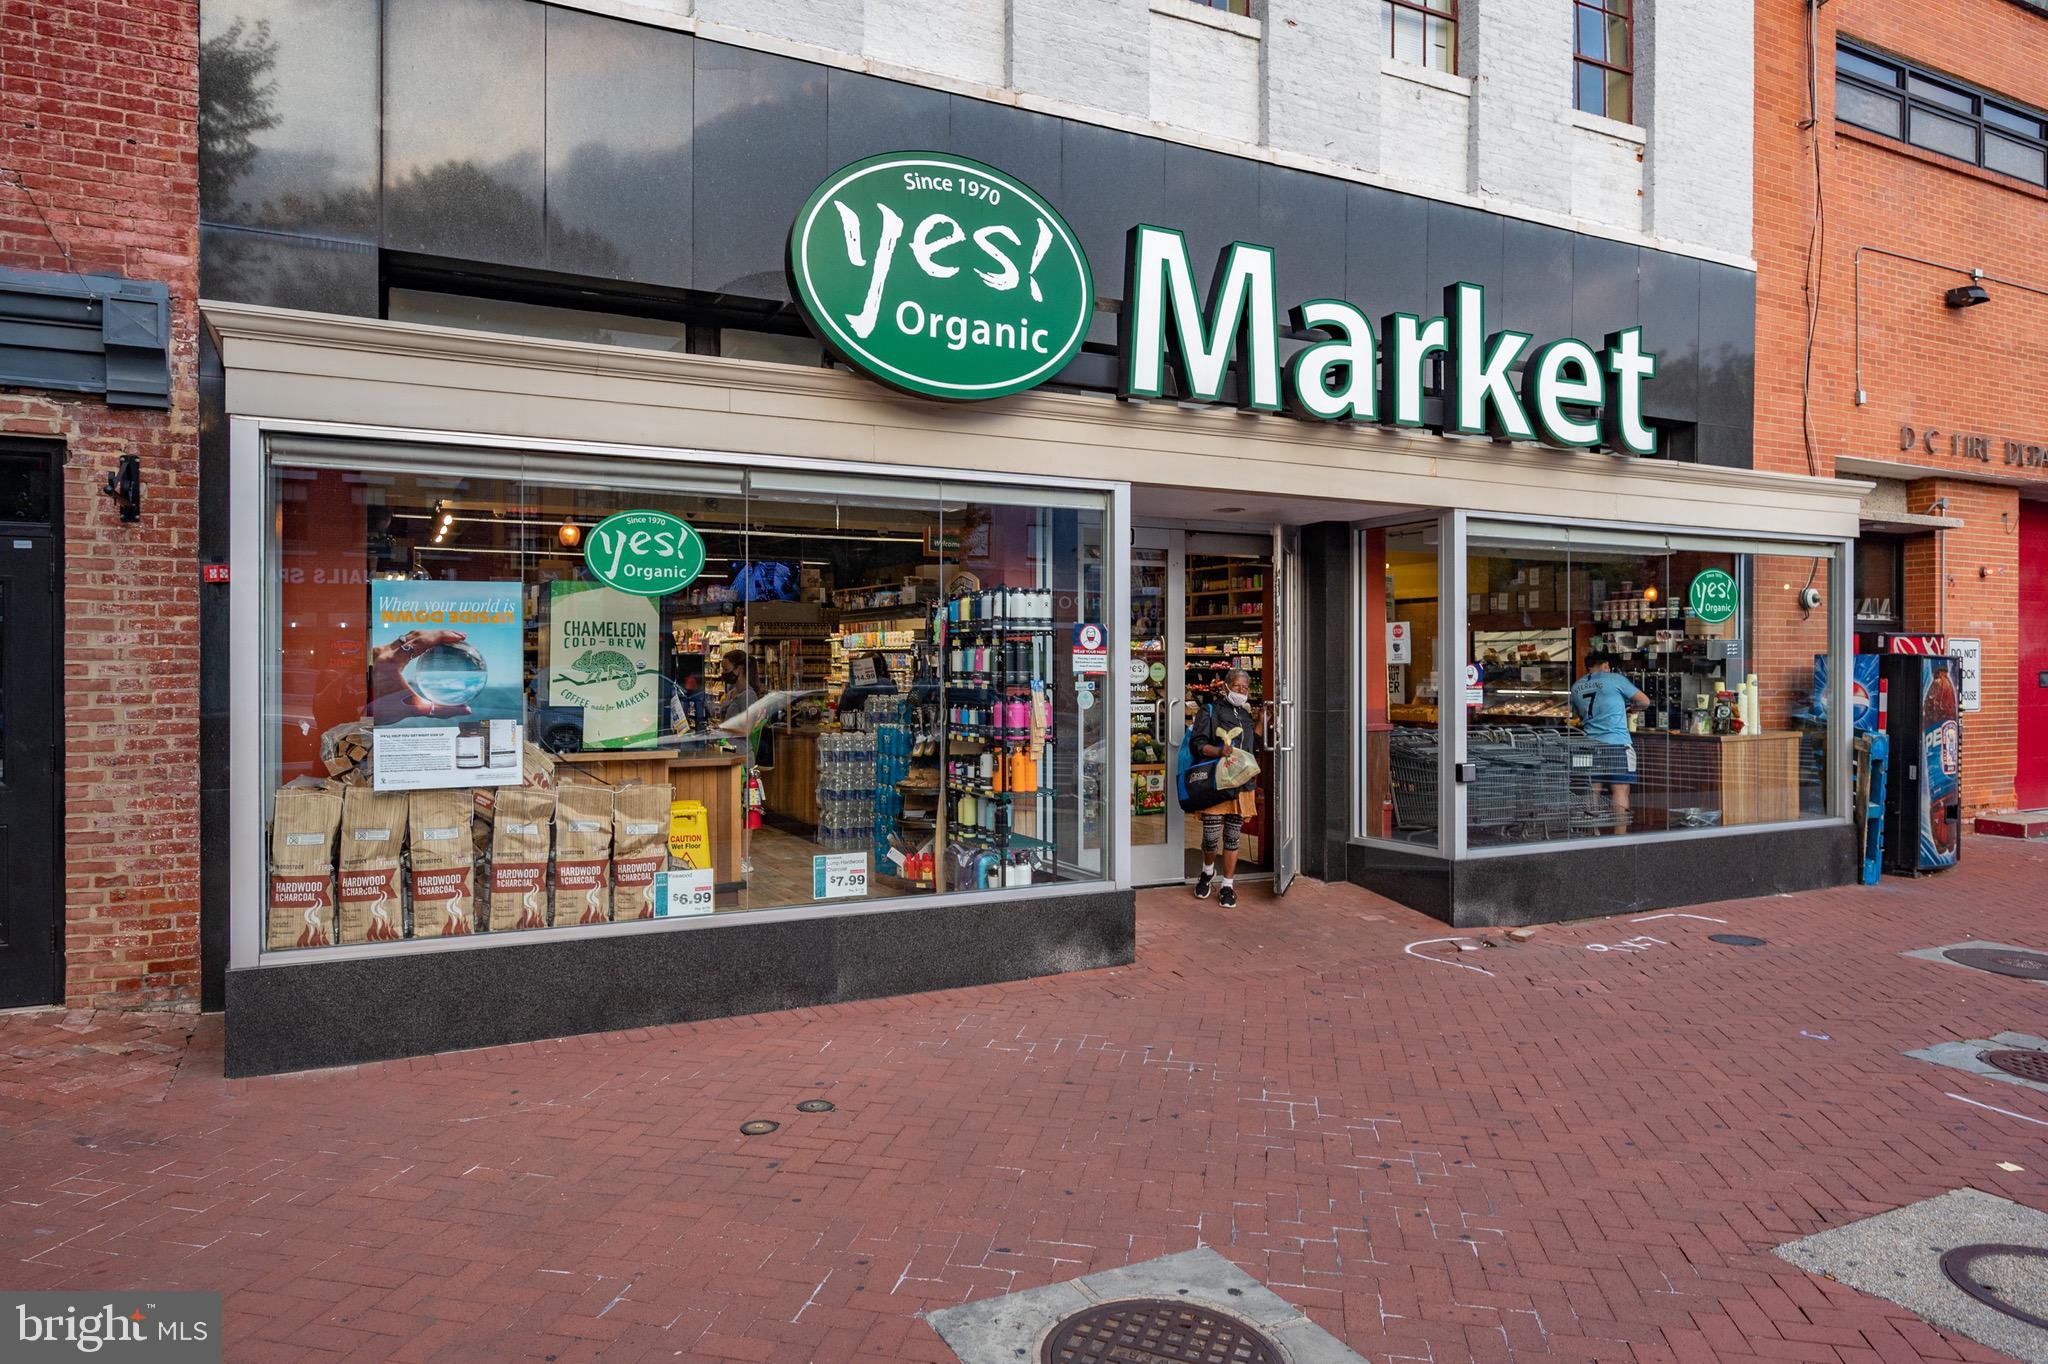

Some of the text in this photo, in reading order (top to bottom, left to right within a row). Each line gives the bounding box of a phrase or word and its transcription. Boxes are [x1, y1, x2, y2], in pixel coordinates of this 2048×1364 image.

[903, 172, 1001, 206] Since 1970
[834, 200, 1054, 339] yes!
[896, 301, 1050, 355] Organic
[1128, 223, 1657, 455] Market
[626, 516, 666, 526] Since 1970
[600, 527, 688, 580] yes!
[623, 563, 687, 580] Organic
[1695, 579, 1732, 614] yes!
[379, 596, 516, 615] When your world is
[1705, 603, 1732, 614] Organic
[381, 609, 444, 625] DOWN
[563, 620, 647, 638] CHAMELEON
[1951, 649, 1977, 658] DO NOT
[1962, 669, 1976, 679] OCK
[560, 688, 591, 708] COFFEE
[616, 688, 650, 710] MAKERS
[1583, 691, 1597, 720] 7
[670, 834, 702, 843] CAUTION
[496, 868, 540, 880] HARDWOOD
[560, 865, 601, 876] HARDWOOD
[617, 862, 657, 874] HARDWOOD
[342, 875, 386, 888] HARDWOOD
[417, 874, 461, 886] HARDWOOD
[564, 875, 596, 885] CHARCOAL
[621, 871, 653, 882] CHARCOAL
[830, 874, 866, 887] $7.99
[276, 881, 323, 893] HARDWOOD
[500, 878, 533, 888] CHARCOAL
[346, 887, 381, 897] CHARCOAL
[421, 885, 457, 895] CHARCOAL
[279, 893, 316, 902] CHARCOAL
[672, 892, 712, 905] $6.99
